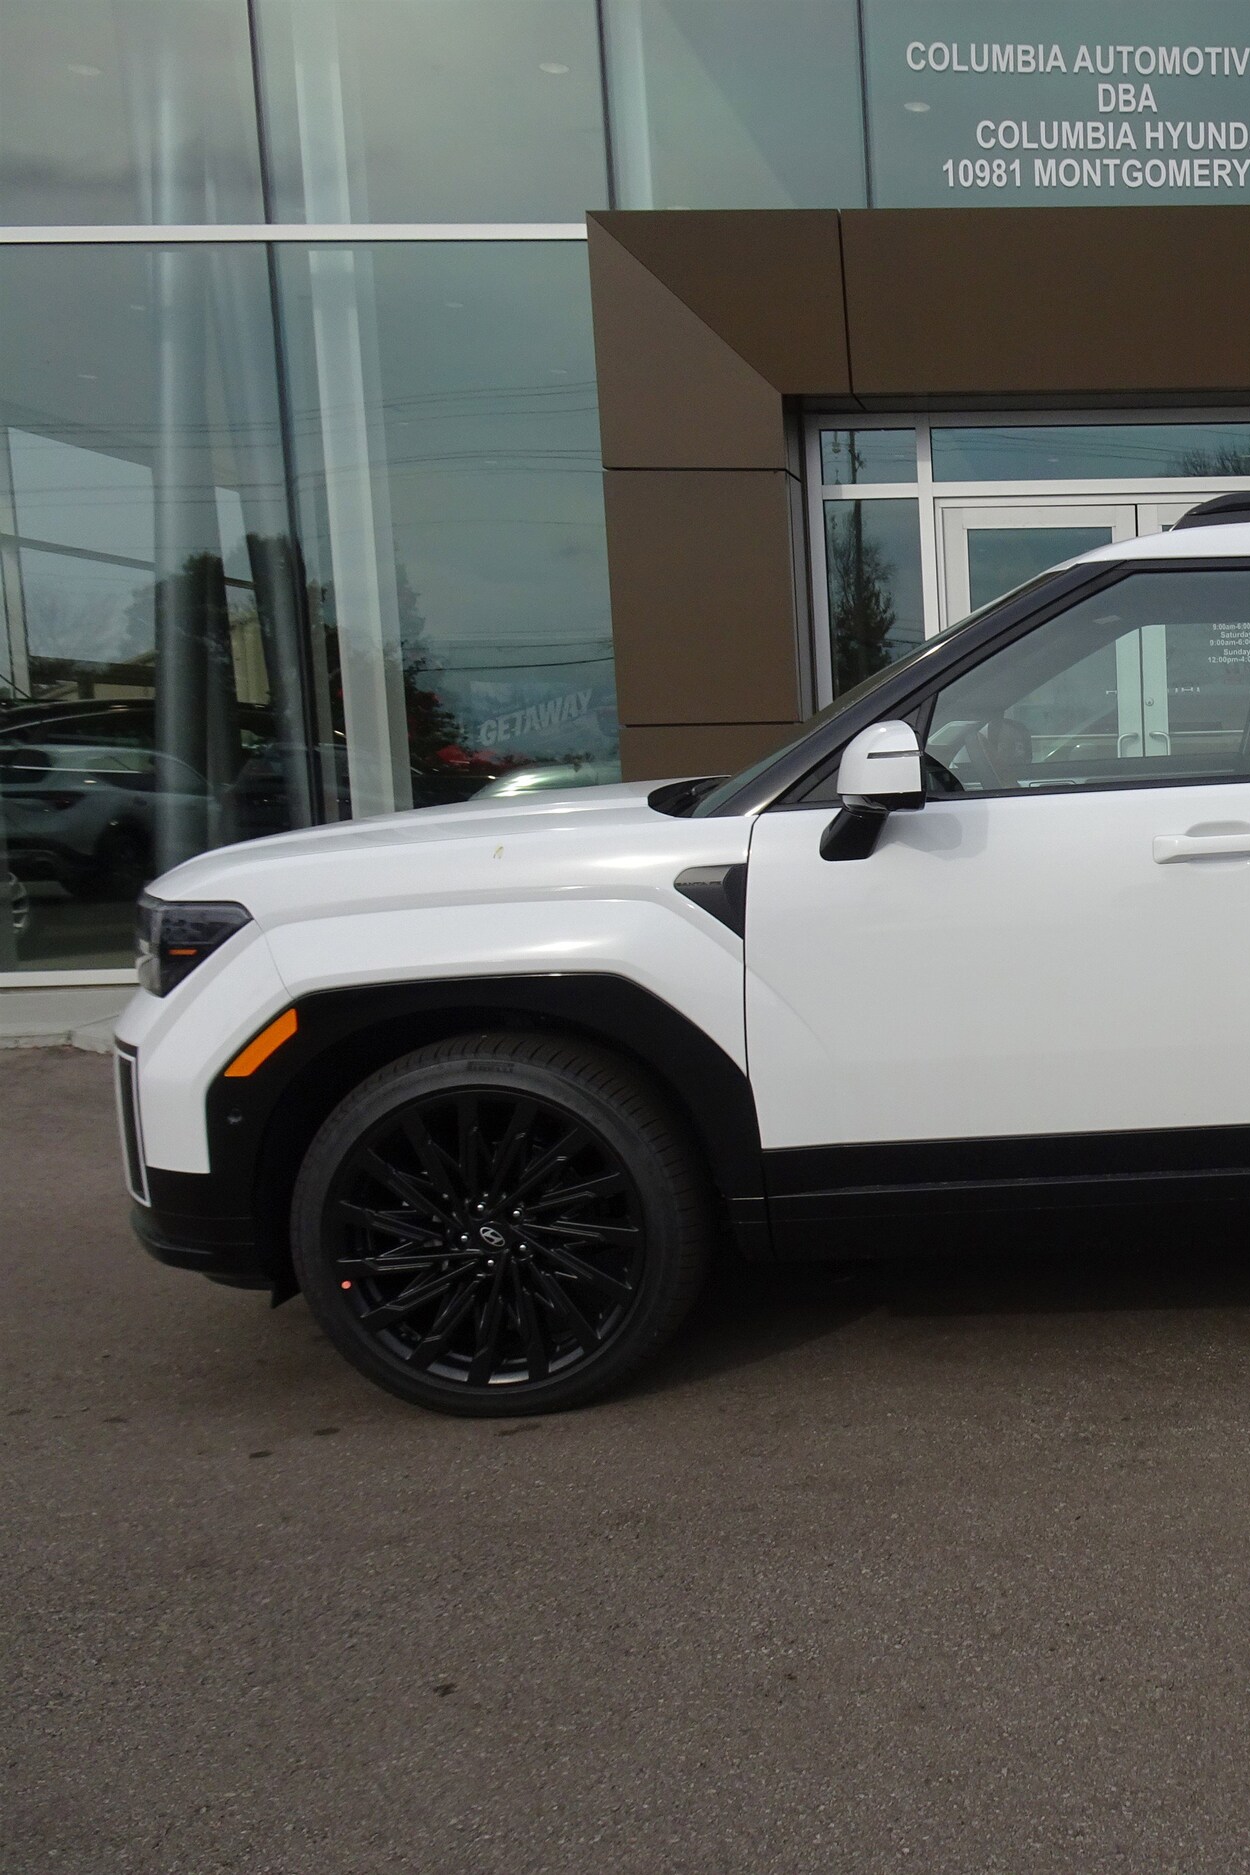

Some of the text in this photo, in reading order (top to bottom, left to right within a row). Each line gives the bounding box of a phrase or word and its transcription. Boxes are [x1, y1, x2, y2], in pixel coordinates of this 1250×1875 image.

[906, 41, 1067, 73] COLUMBIA
[1097, 83, 1158, 113] DBA
[976, 120, 1137, 150] COLUMBIA
[943, 159, 1021, 188] 10981
[1223, 648, 1250, 656] Sunday
[477, 688, 593, 747] GETAWAY
